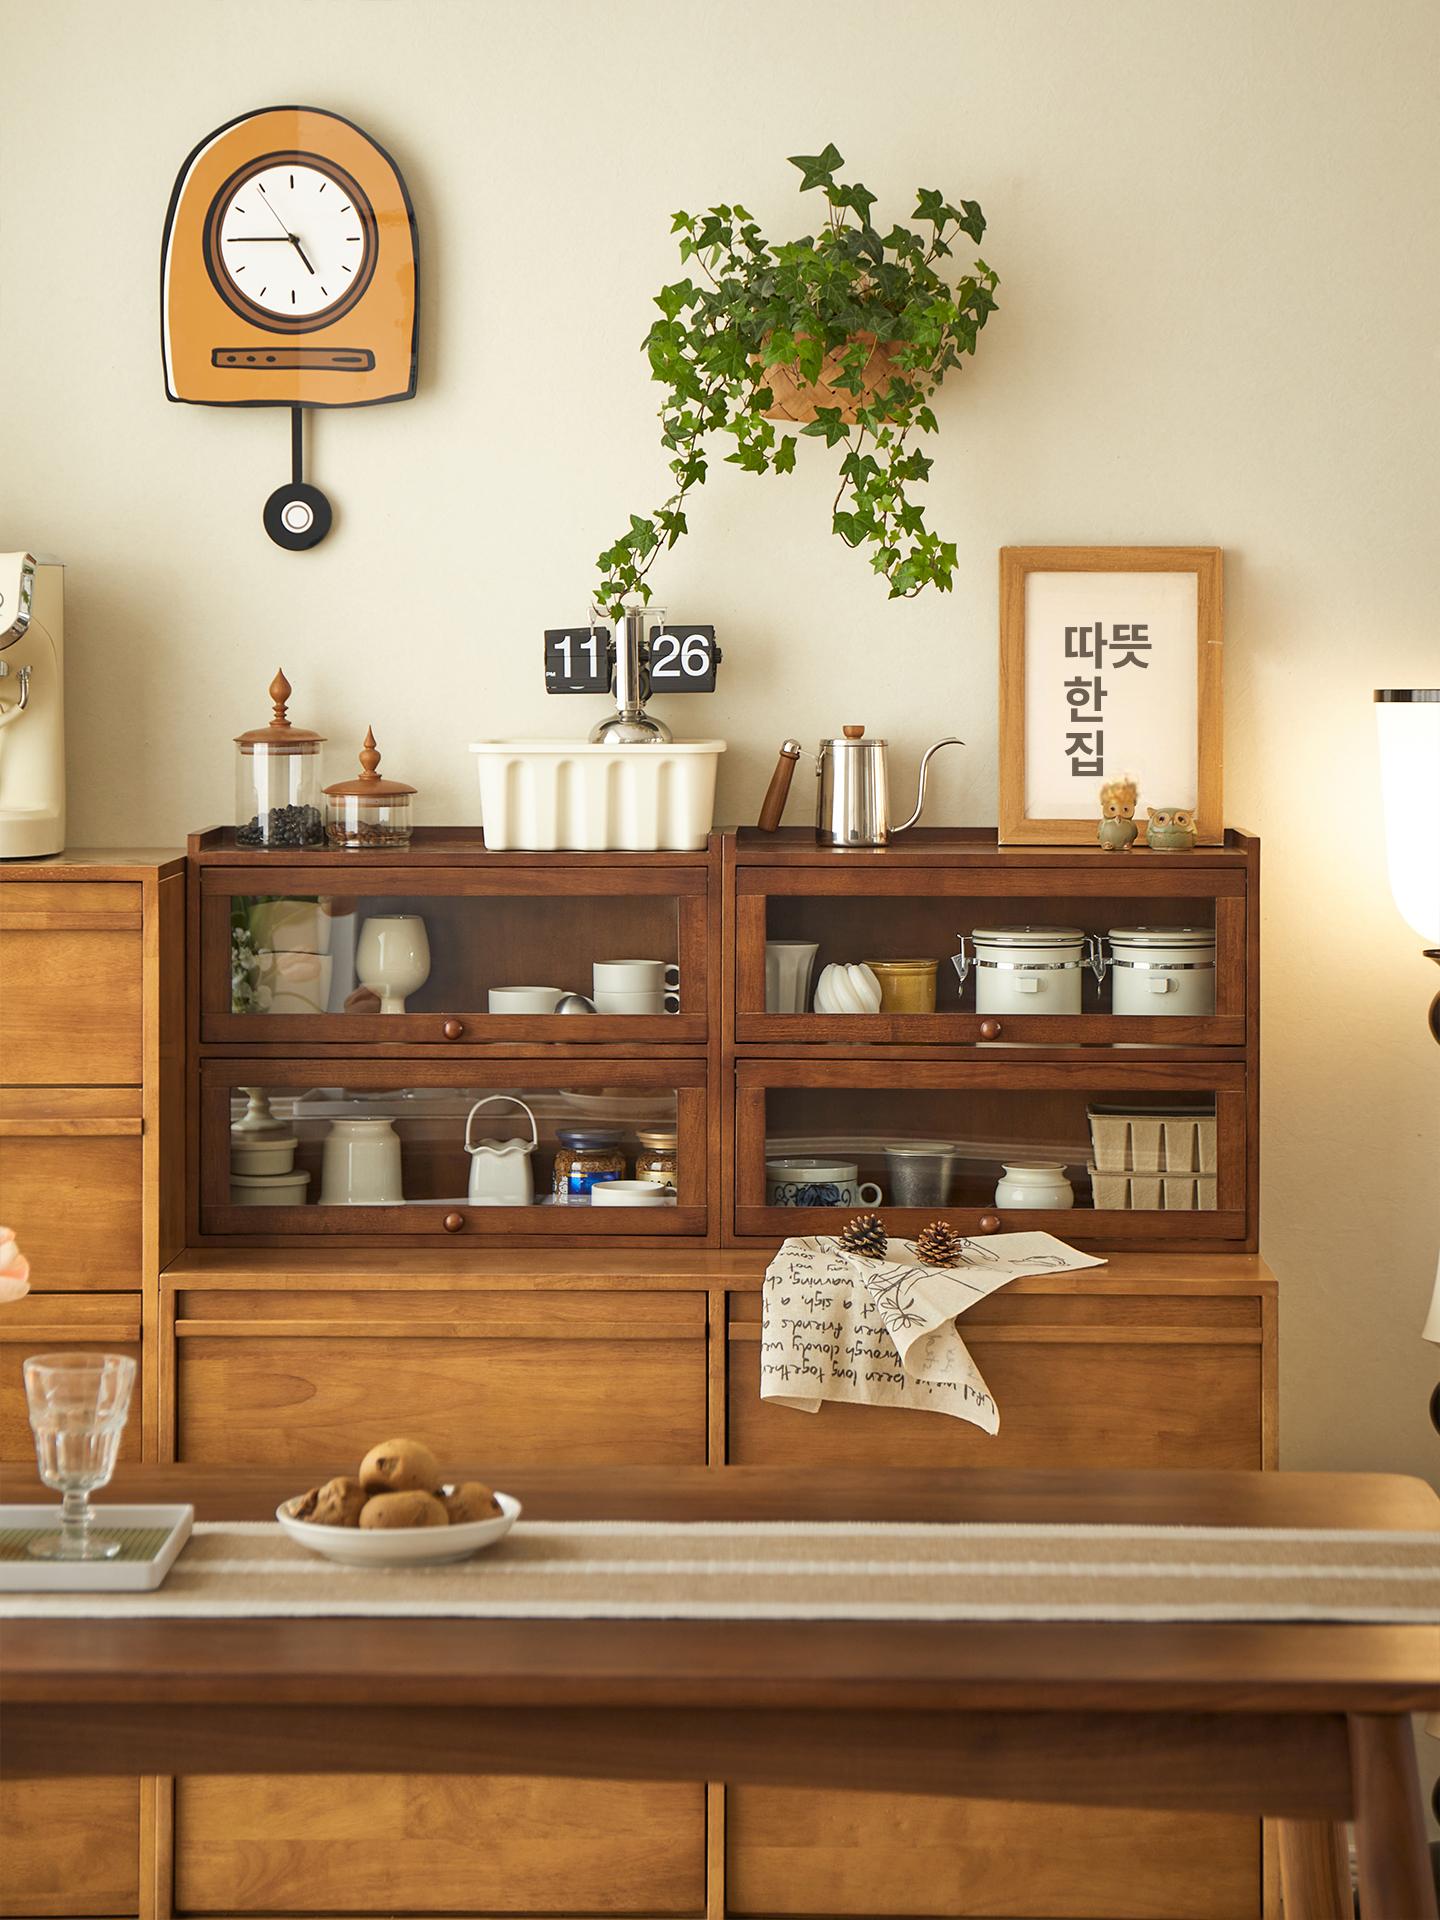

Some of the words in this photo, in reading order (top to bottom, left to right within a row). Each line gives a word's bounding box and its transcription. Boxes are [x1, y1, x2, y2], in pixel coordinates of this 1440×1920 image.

[554, 635, 597, 678] 11
[652, 634, 710, 677] 26
[1064, 621, 1152, 669] 따뜻
[1064, 676, 1108, 722] 한
[1064, 730, 1103, 776] 집
[781, 1297, 791, 1306] a
[843, 1300, 853, 1310] a
[781, 1319, 843, 1340] friends
[793, 1335, 840, 1361] cloudy
[832, 1361, 857, 1386] long
[865, 1371, 904, 1391] been
